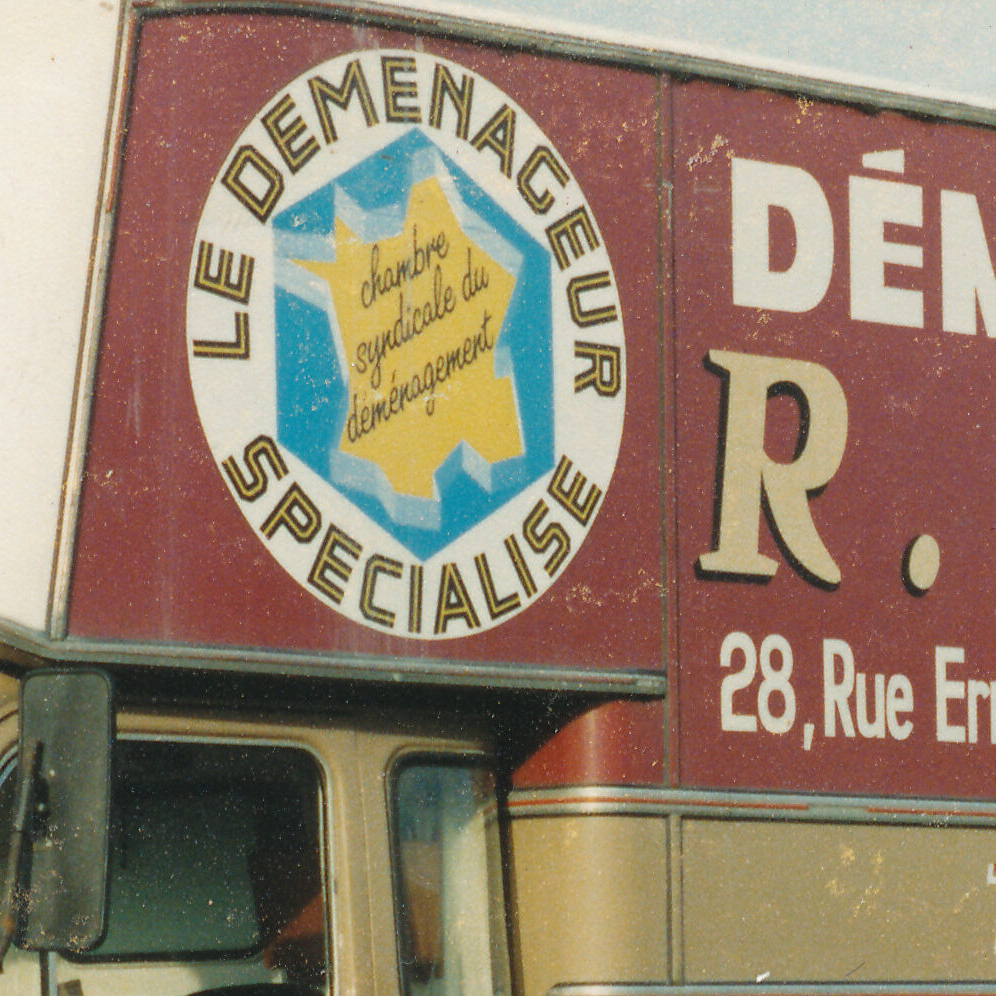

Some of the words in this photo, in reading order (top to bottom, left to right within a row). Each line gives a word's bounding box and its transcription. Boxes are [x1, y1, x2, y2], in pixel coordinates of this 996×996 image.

[220, 55, 622, 399] DEMENAGEUR
[361, 223, 450, 309] chambre
[192, 240, 256, 361] LE
[355, 264, 456, 390] syndicale
[461, 247, 490, 302] du
[221, 433, 604, 635] SPECIALISE
[935, 645, 996, 744] Er
